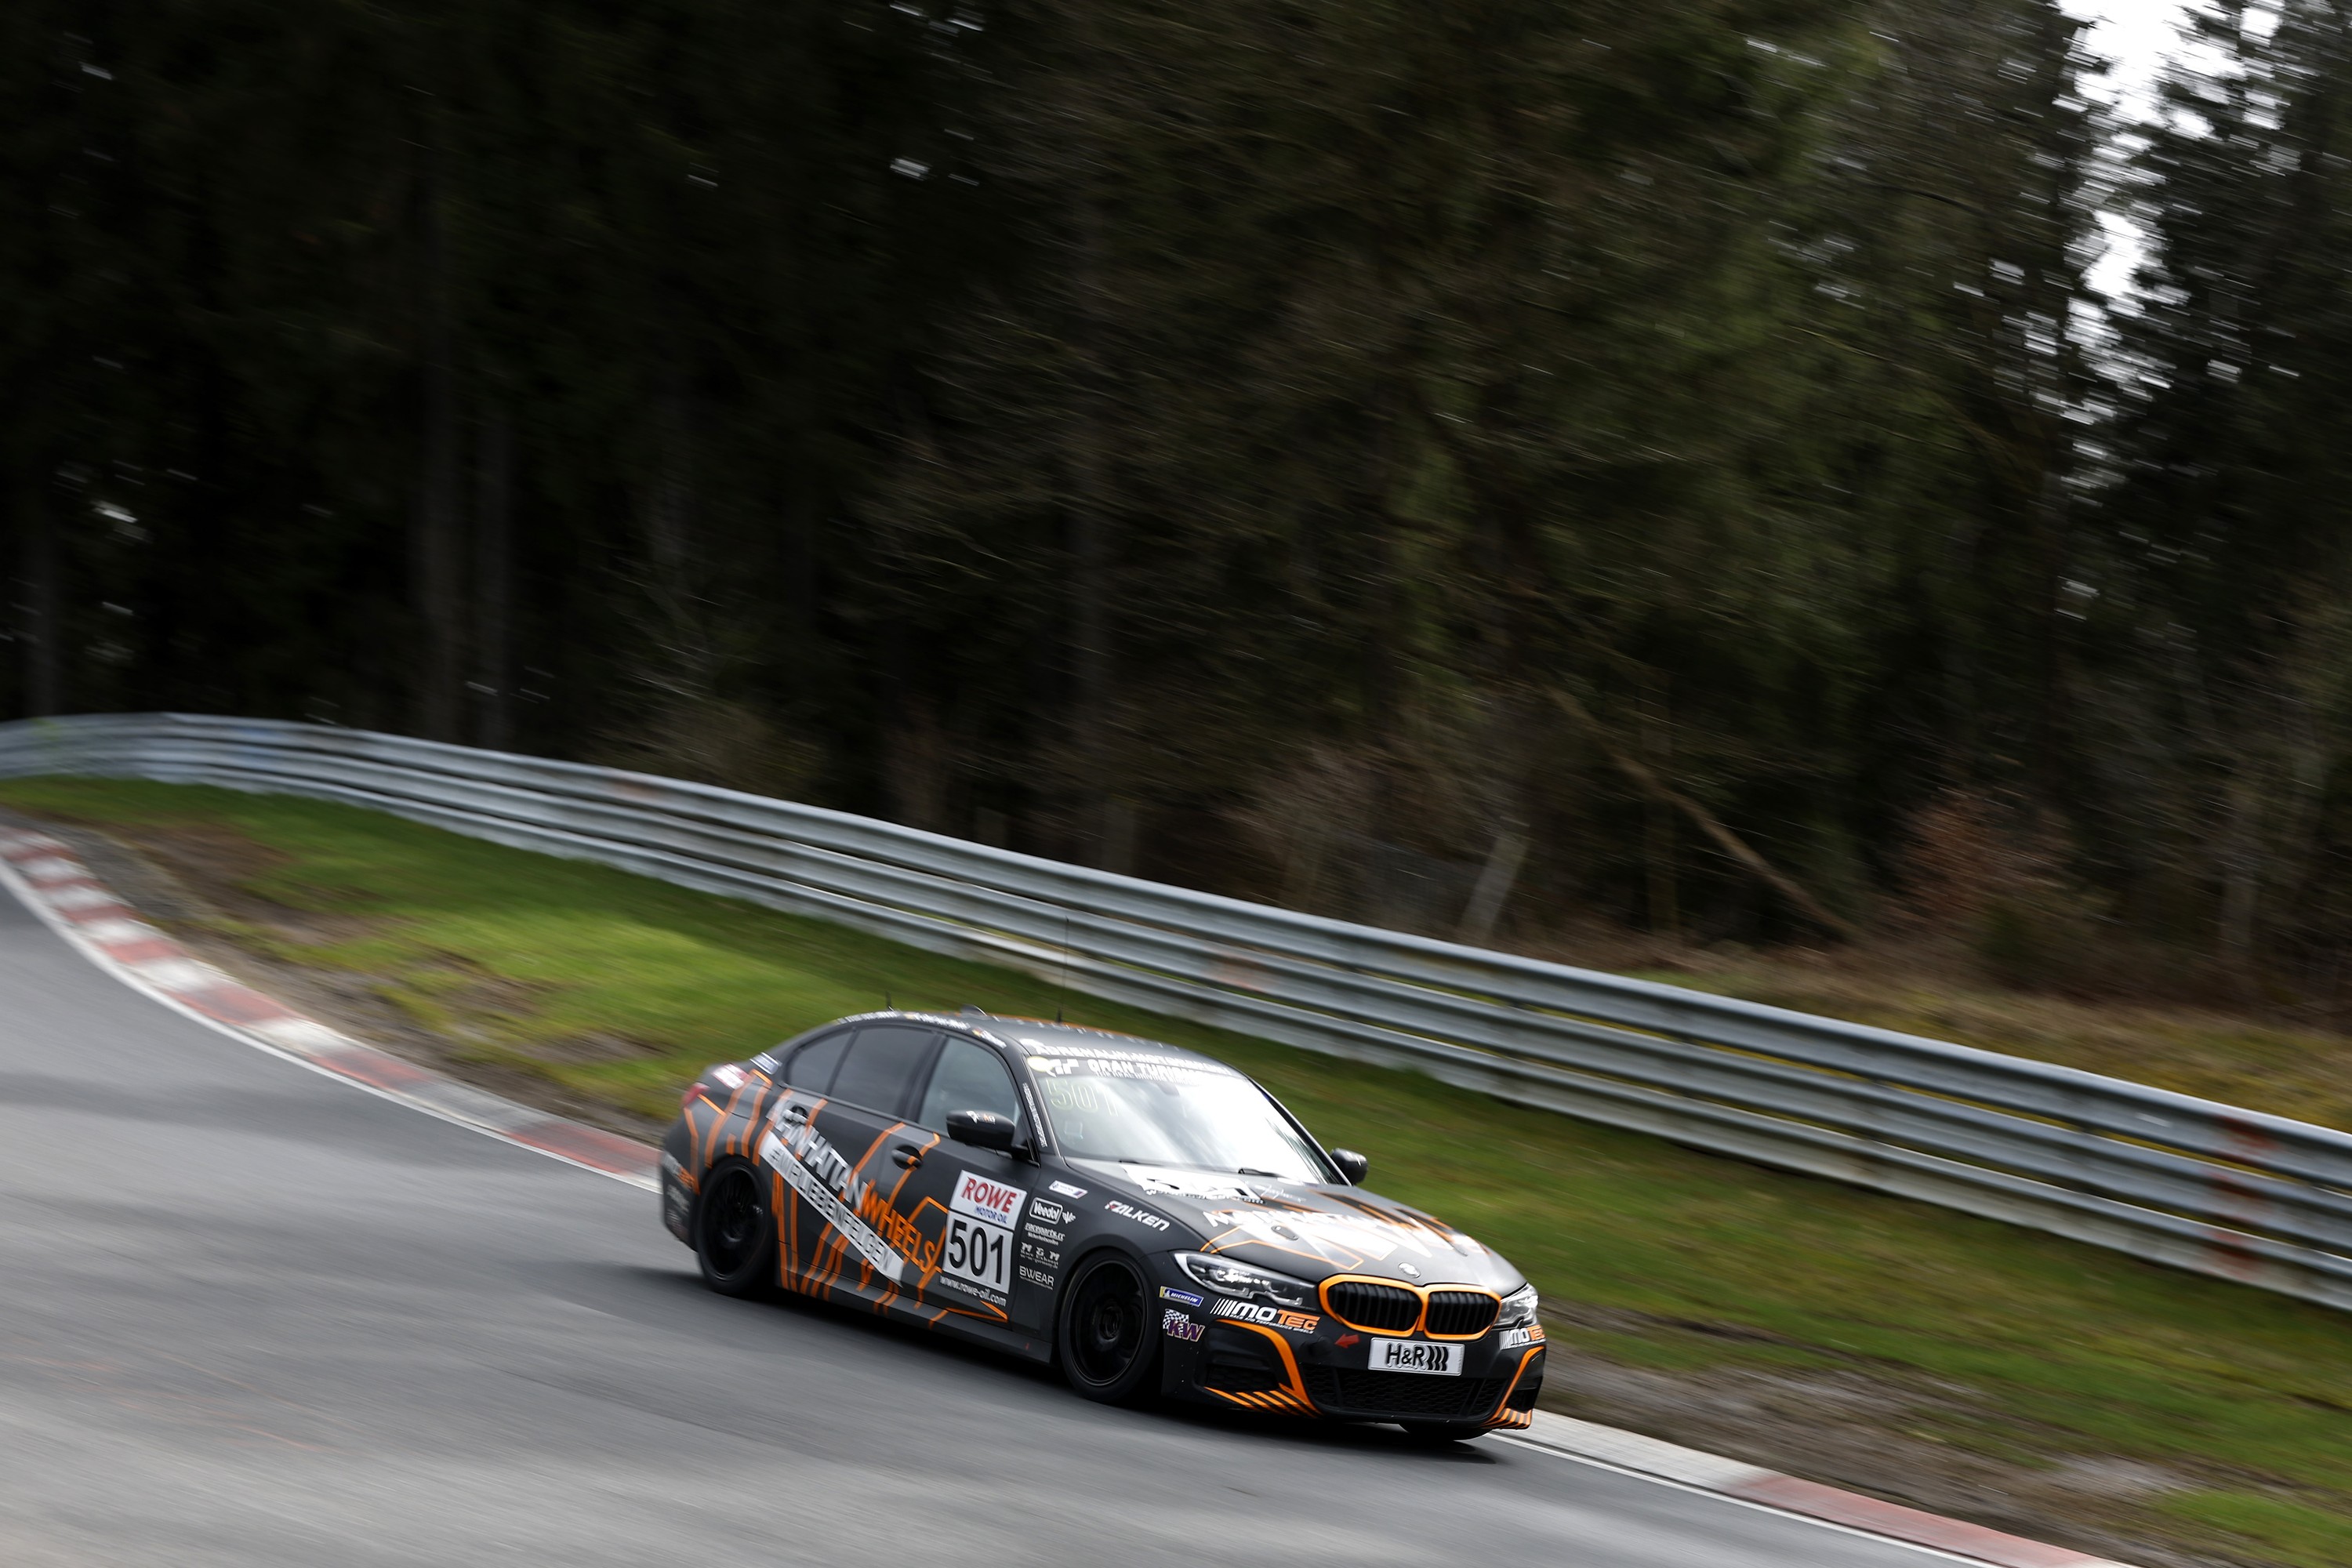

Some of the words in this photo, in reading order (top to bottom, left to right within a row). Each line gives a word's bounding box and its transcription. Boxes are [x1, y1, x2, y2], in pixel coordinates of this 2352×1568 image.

[1087, 1058, 1135, 1076] GRAN
[1045, 1077, 1119, 1117] 501
[961, 1177, 1017, 1214] ROWE
[974, 1205, 997, 1221] MOTOR
[997, 1213, 1008, 1225] OIL
[1033, 1201, 1060, 1220] Veedol
[1104, 1200, 1171, 1232] FALKEN
[860, 1179, 936, 1273] WHEELS
[947, 1218, 1004, 1285] 501
[1019, 1265, 1054, 1287] BWEAR
[940, 1276, 1007, 1307] www.rowe-oil.com
[1171, 1292, 1199, 1304] MICHELIN
[1167, 1319, 1205, 1342] KW
[1255, 1319, 1293, 1330] PERFORMANCE
[1385, 1341, 1426, 1368] H&R
